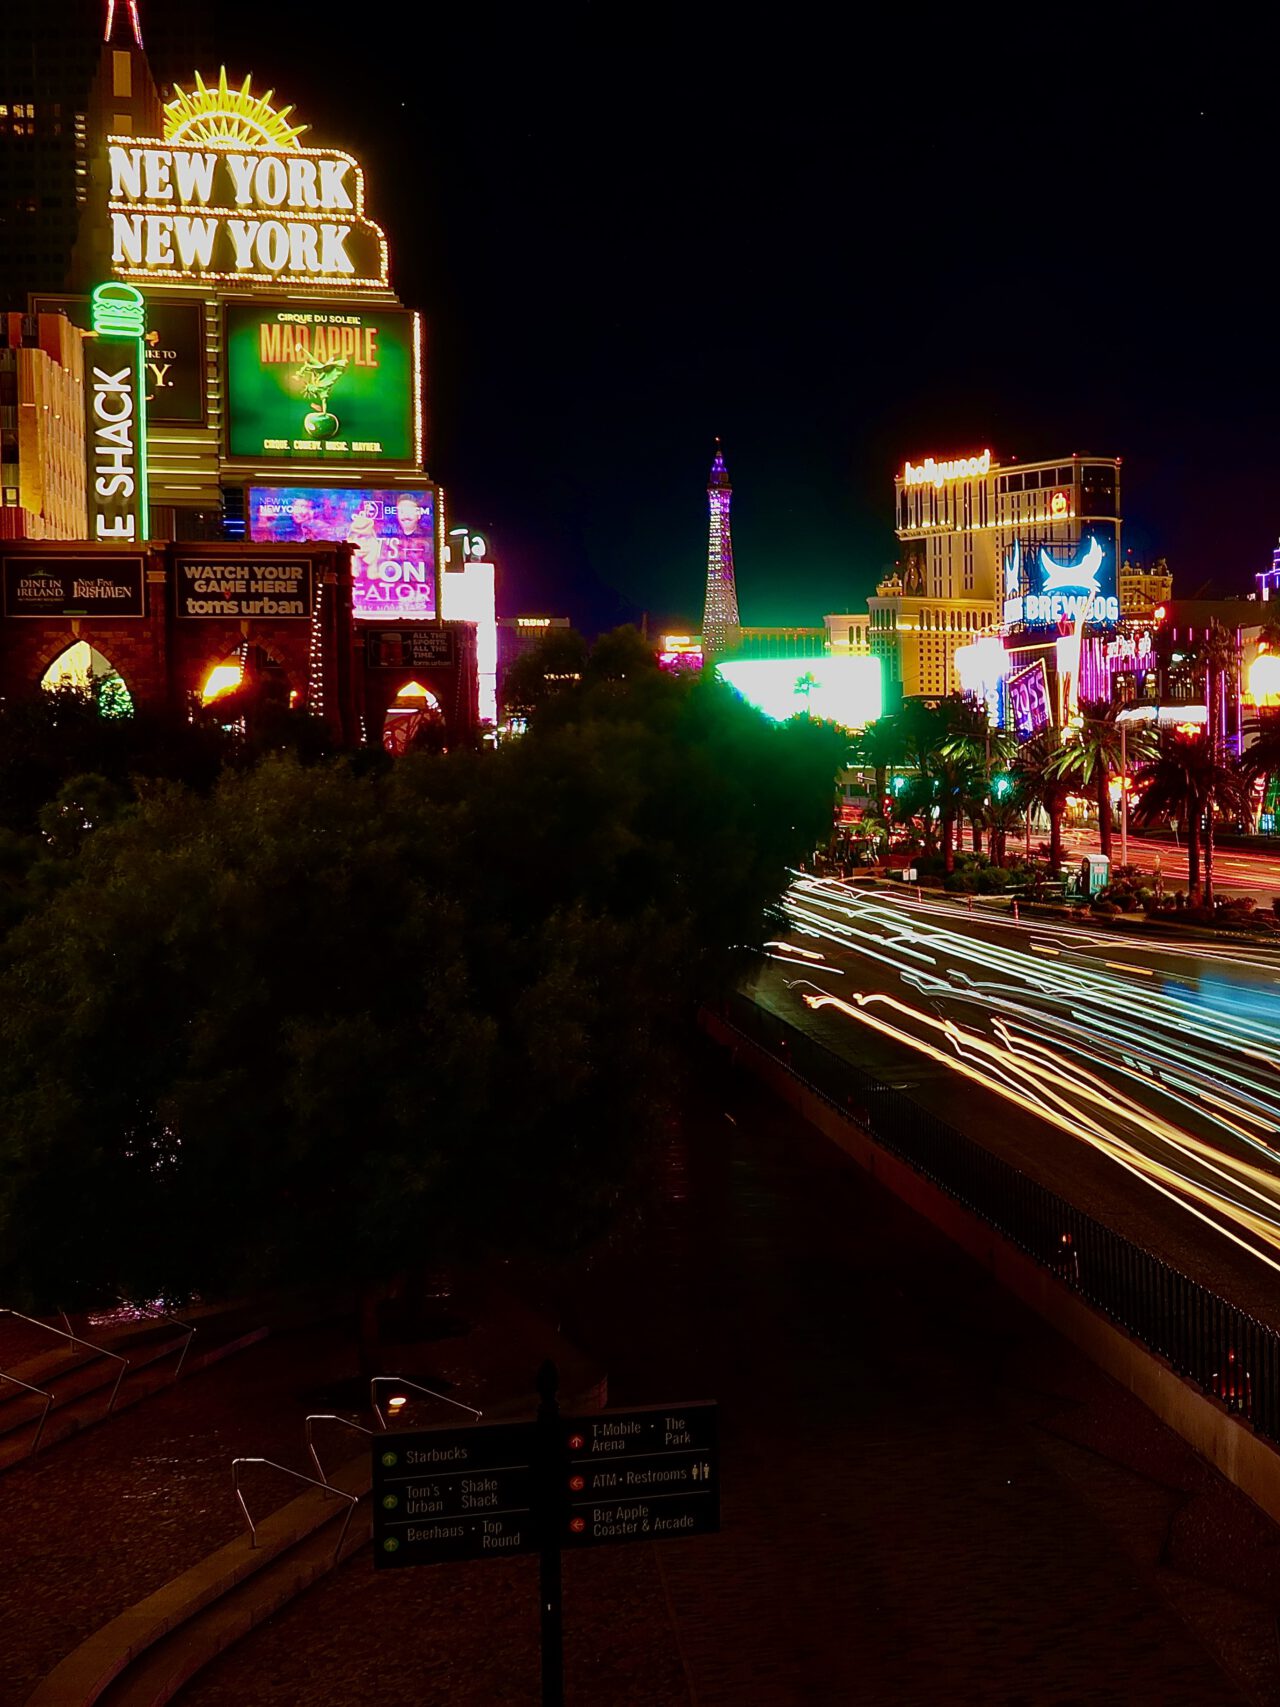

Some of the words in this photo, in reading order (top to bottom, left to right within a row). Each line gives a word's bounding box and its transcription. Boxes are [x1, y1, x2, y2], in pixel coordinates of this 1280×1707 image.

[108, 147, 217, 202] NEW
[226, 154, 353, 209] YORK
[110, 213, 218, 266] NEW
[228, 220, 355, 273] YORK
[277, 313, 313, 324] CIRQUE
[314, 314, 328, 323] DU
[260, 323, 311, 363] MAD
[313, 325, 379, 368] APPLE
[92, 366, 135, 498] SHACK
[905, 448, 990, 488] hollywood
[384, 506, 430, 515] BEGM
[184, 566, 249, 579] WATCH
[253, 566, 303, 579] YOUR
[379, 561, 425, 582] ON
[20, 579, 46, 588] DINE
[49, 579, 62, 588] IN
[73, 581, 132, 598] IRISHMEN
[194, 580, 246, 593] GAME
[250, 580, 298, 593] HERE
[186, 598, 239, 614] toms
[241, 597, 304, 614] urban
[517, 618, 551, 627] TRUMP
[592, 1421, 641, 1437] T-Mobile
[665, 1417, 685, 1430] The
[592, 1439, 625, 1452] Arena
[665, 1431, 691, 1445] Park
[406, 1446, 468, 1464] Starbucks
[592, 1473, 617, 1488] ATM
[626, 1469, 687, 1485] Restrooms
[406, 1483, 440, 1499] Tom's
[461, 1478, 498, 1494] Shake
[406, 1500, 443, 1514] Urban
[461, 1493, 498, 1509] Shack
[593, 1508, 612, 1523] Big
[616, 1505, 649, 1521] Apple
[407, 1526, 464, 1542] Beerhaus
[482, 1520, 503, 1535] Top
[593, 1522, 638, 1537] Coaster
[641, 1519, 650, 1532] &
[654, 1515, 694, 1531] Arcade
[482, 1533, 521, 1548] Round
